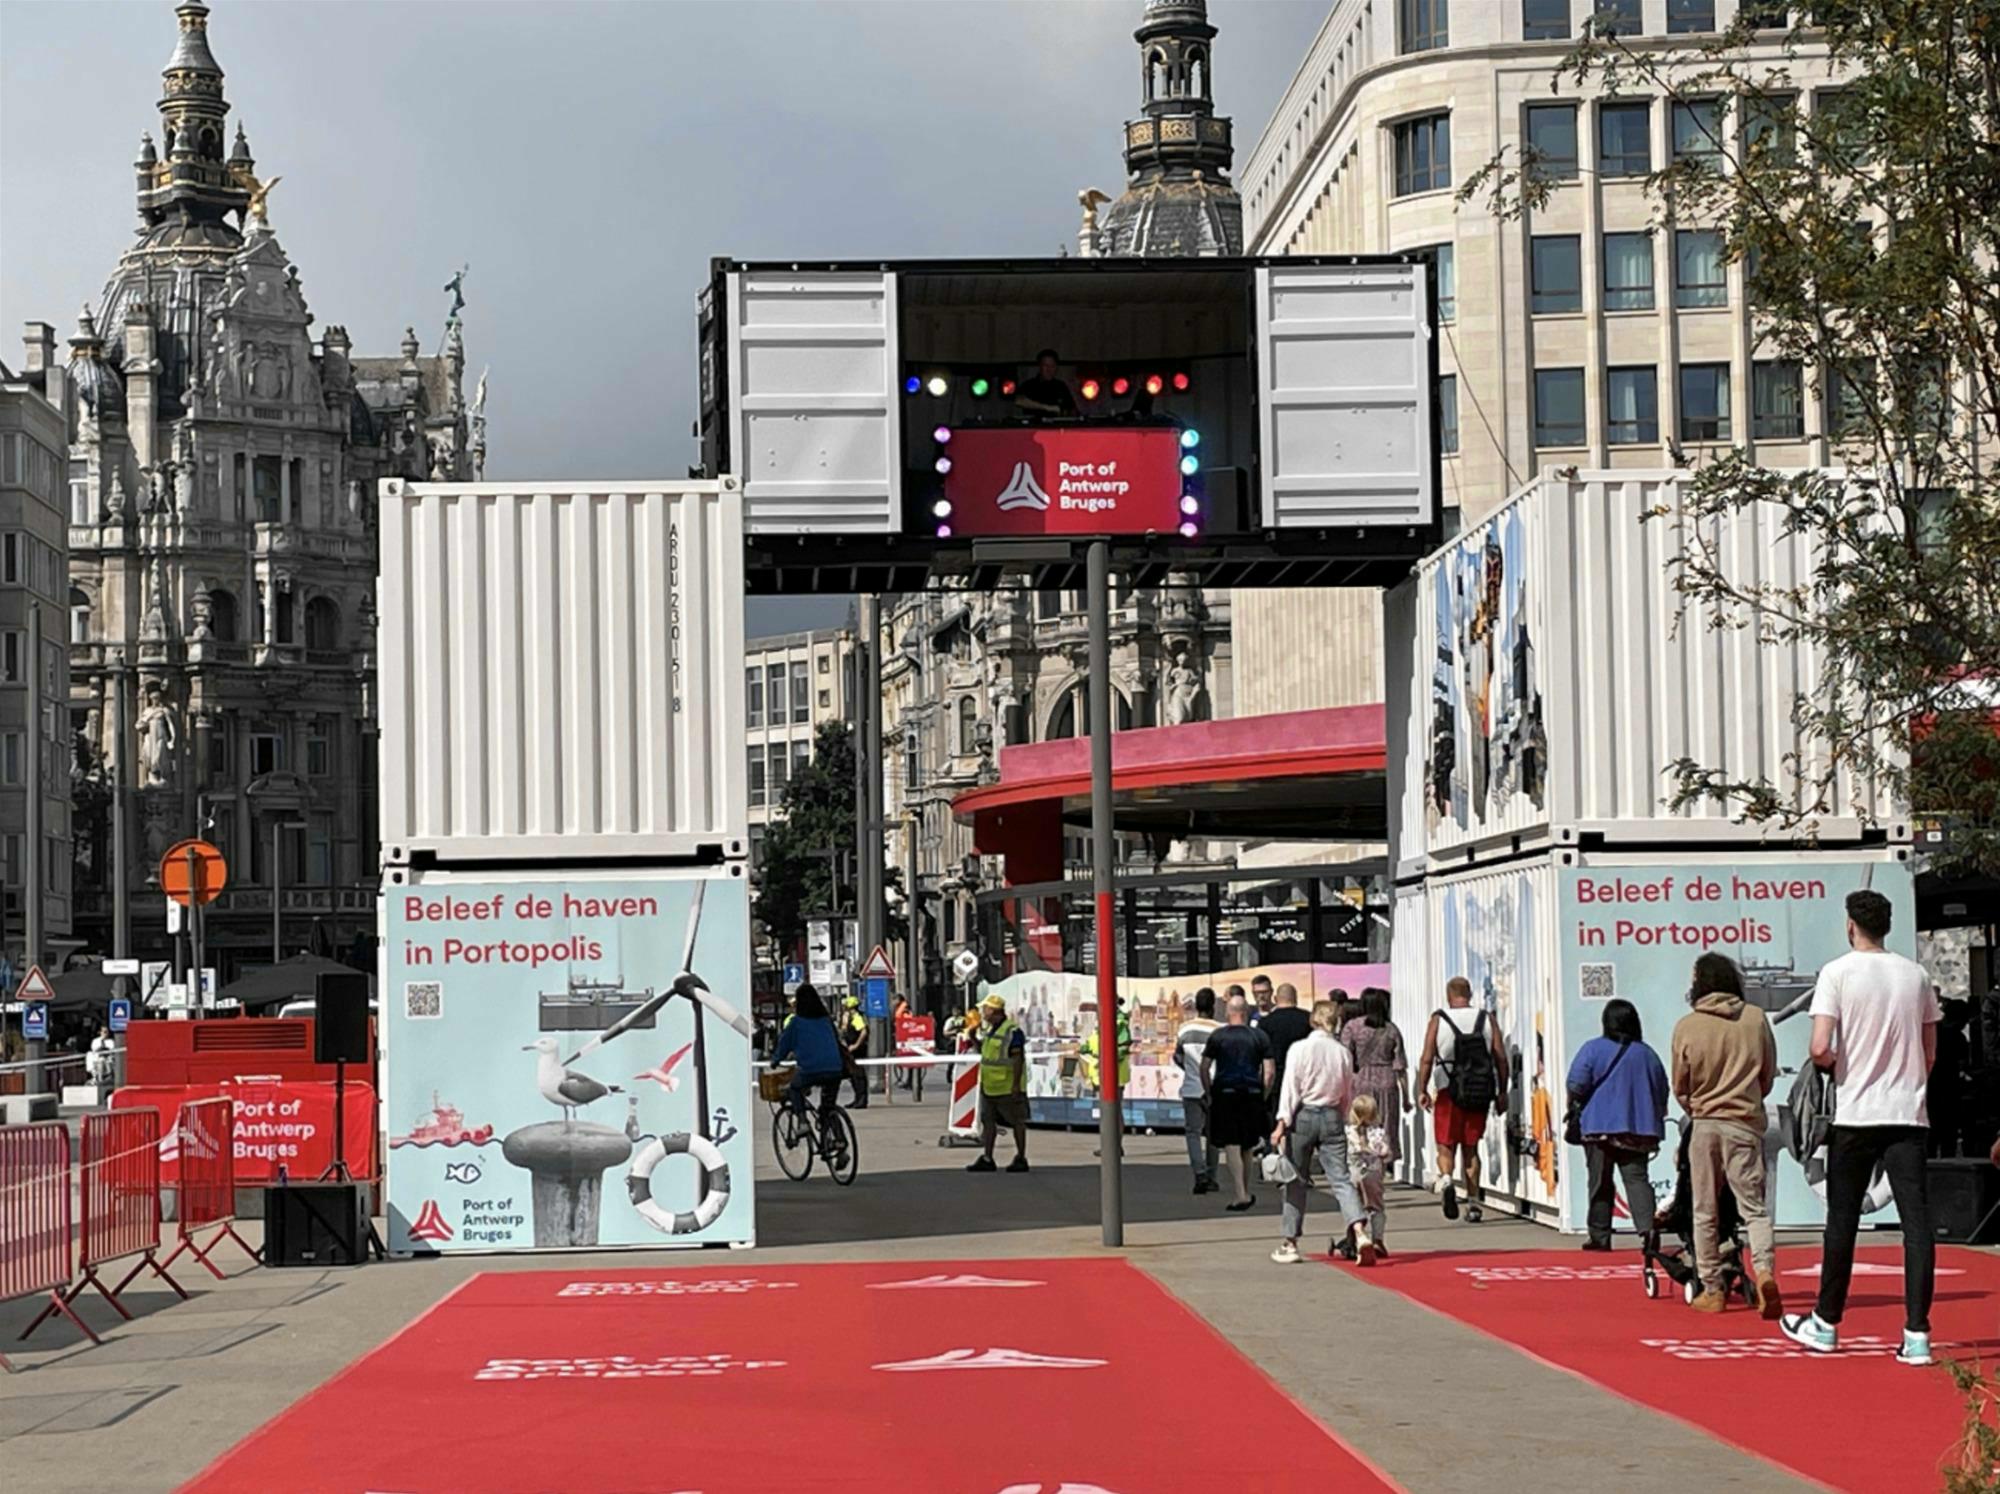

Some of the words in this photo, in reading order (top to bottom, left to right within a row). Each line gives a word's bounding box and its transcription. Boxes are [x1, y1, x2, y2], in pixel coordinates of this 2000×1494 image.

[1058, 461, 1095, 476] Port
[1097, 461, 1117, 476] of
[1058, 479, 1130, 496] Antwerp
[1059, 495, 1117, 513] Bruges
[669, 522, 679, 588] ARDU
[1576, 877, 1674, 904] Beleef
[1685, 876, 1722, 902] de
[1732, 874, 1826, 901] haven
[404, 894, 504, 921] Beleef
[515, 893, 553, 920] de
[563, 892, 658, 918] haven
[1577, 921, 1605, 947] in
[1615, 918, 1773, 950] Portopolis
[405, 939, 433, 965] in
[443, 935, 603, 968] Portopolis
[232, 1100, 275, 1118] Port
[279, 1099, 302, 1116] of
[232, 1121, 316, 1141] Antwerp
[232, 1141, 298, 1162] Bruges
[463, 1198, 494, 1211] Port
[497, 1197, 513, 1210] of
[462, 1213, 525, 1228] Antwerp
[463, 1228, 513, 1243] Bruges
